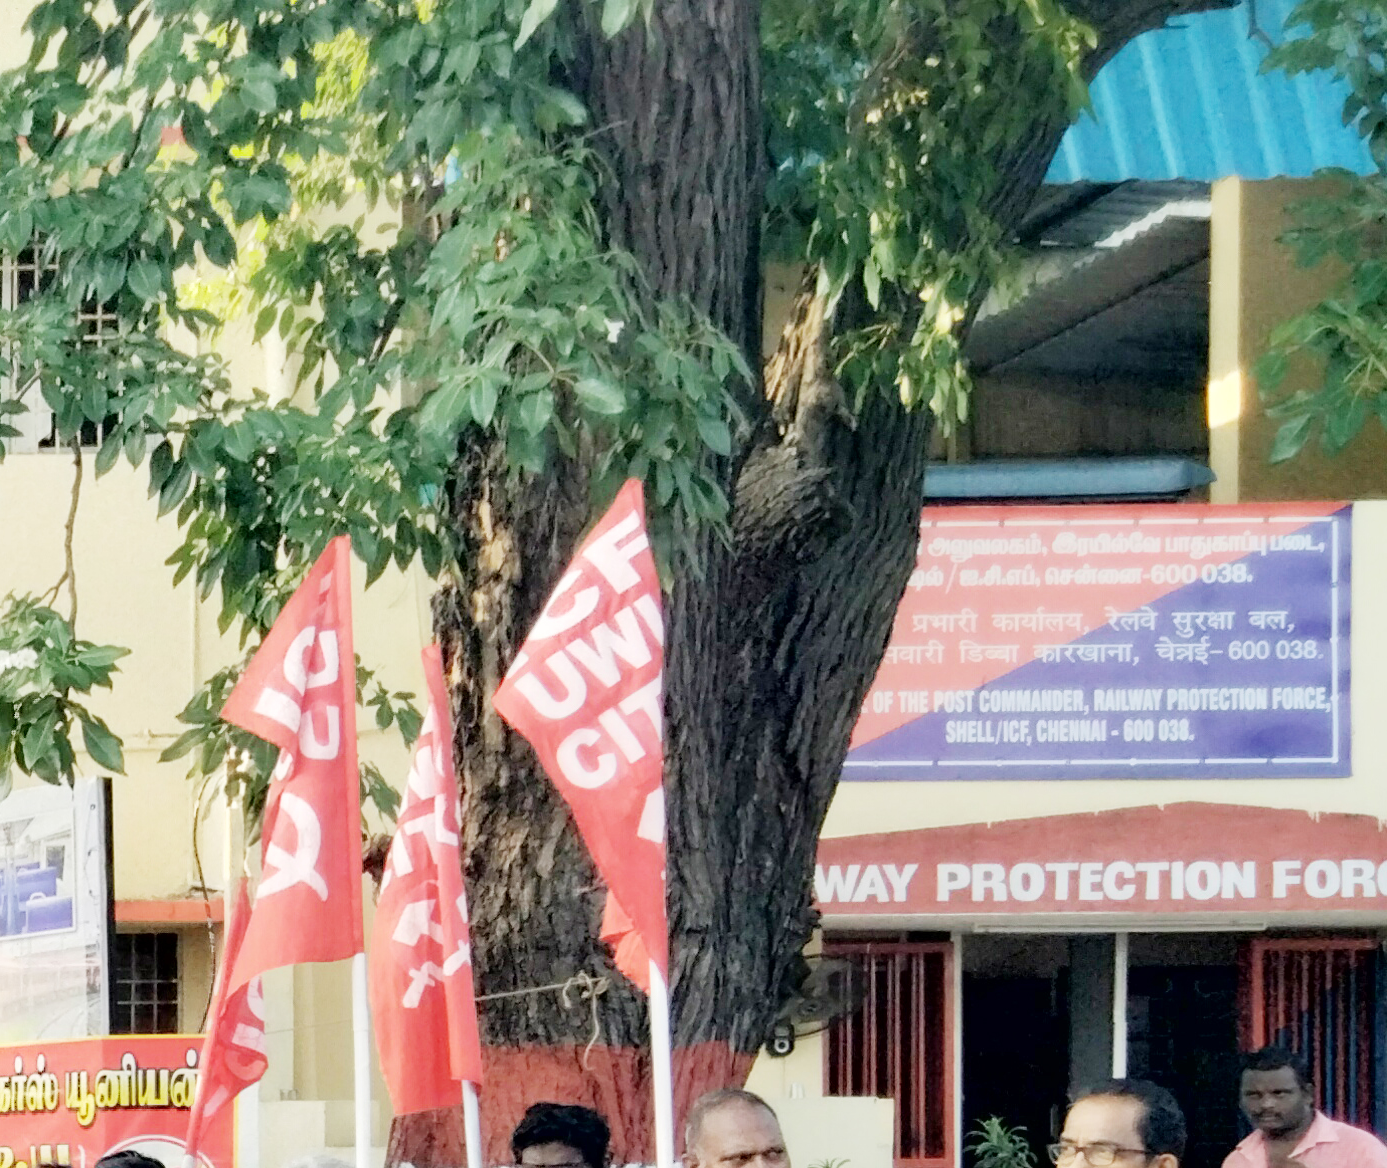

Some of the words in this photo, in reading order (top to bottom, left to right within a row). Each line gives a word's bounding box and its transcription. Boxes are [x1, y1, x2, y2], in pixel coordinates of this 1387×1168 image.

[1200, 562, 1254, 584] 038.
[505, 509, 650, 678] CF
[912, 607, 979, 634] प्रभारी
[991, 605, 1090, 636] कार्यालय,
[1103, 605, 1159, 632] रेलवे
[1170, 609, 1236, 639] सुरक्षा
[1247, 609, 1296, 634] बल,
[958, 639, 1021, 664] डिब्बा
[1033, 642, 1140, 667] कारखाना,
[1228, 639, 1270, 661] 600
[1276, 639, 1325, 661] 038.
[872, 690, 895, 714] OF
[898, 690, 930, 714] THE
[933, 689, 976, 713] POST
[979, 689, 1090, 716] COMMANDER,
[1093, 688, 1164, 712] RAILWAY
[1166, 686, 1268, 712] PROTECTION
[1272, 686, 1332, 713] FORCE,
[556, 668, 664, 790] CIT
[945, 718, 1033, 747] SHELL/ICF,
[1036, 718, 1107, 742] CHENNAI
[1123, 718, 1155, 742] 600
[1158, 718, 1195, 742] 038.
[936, 860, 1256, 904] PROTECTION
